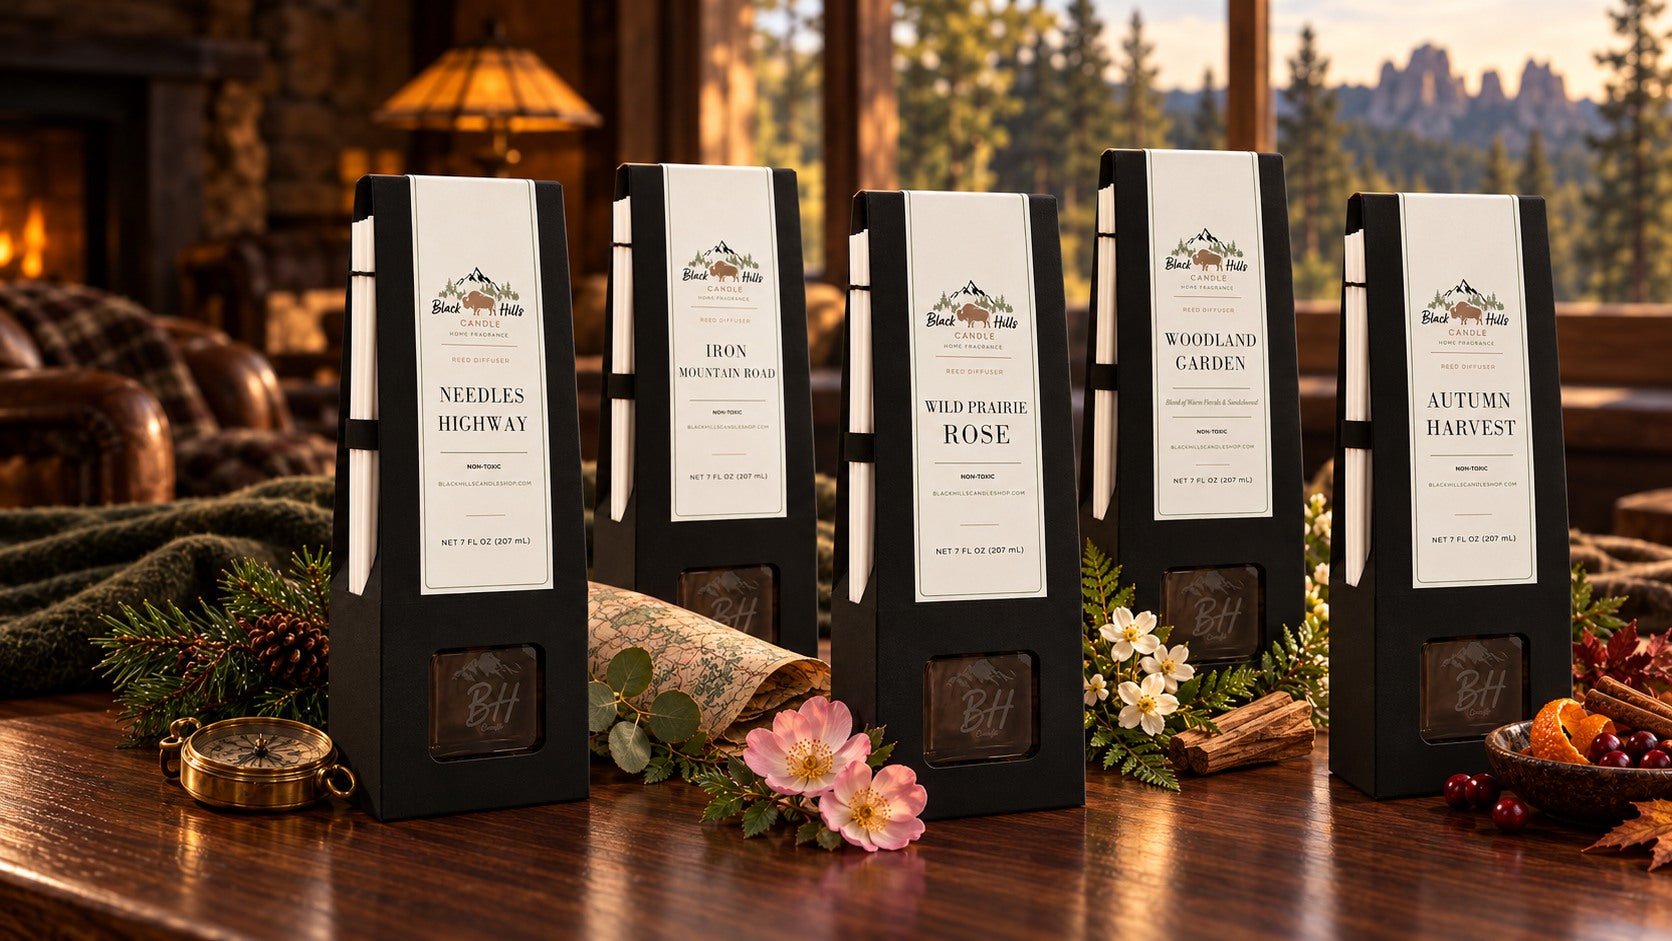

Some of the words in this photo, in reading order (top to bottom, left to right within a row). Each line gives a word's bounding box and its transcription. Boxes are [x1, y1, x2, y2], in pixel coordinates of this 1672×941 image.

[1165, 257, 1192, 270] Black
[1226, 259, 1248, 272] Hills
[683, 268, 709, 281] Black
[742, 271, 763, 283] Hills
[432, 299, 461, 314] Black
[500, 302, 524, 317] Hills
[460, 319, 500, 328] CANDLE
[926, 312, 955, 327] Black
[993, 315, 1018, 329] Hills
[1422, 310, 1449, 324] Black
[1486, 312, 1509, 326] Hills
[955, 332, 995, 340] CANDLE
[1165, 333, 1256, 347] WOODLAND
[706, 344, 746, 358] IRON
[1176, 356, 1245, 370] GARDEN
[680, 367, 740, 378] MOUNTAIN
[744, 368, 776, 378] ROAD
[440, 387, 524, 403] NEEDLES
[1427, 392, 1510, 408] AUTUMN
[925, 400, 963, 413] WILD
[968, 401, 1027, 414] PRAIRIE
[439, 416, 527, 431] HIGHWAY
[1427, 420, 1516, 436] HARVEST
[944, 424, 1010, 444] ROSE
[515, 537, 530, 545] mL)
[1009, 546, 1024, 554] mL)
[1193, 597, 1242, 636] BH
[1455, 670, 1506, 712] BH
[466, 682, 520, 728] BH
[960, 689, 1014, 733] BH
